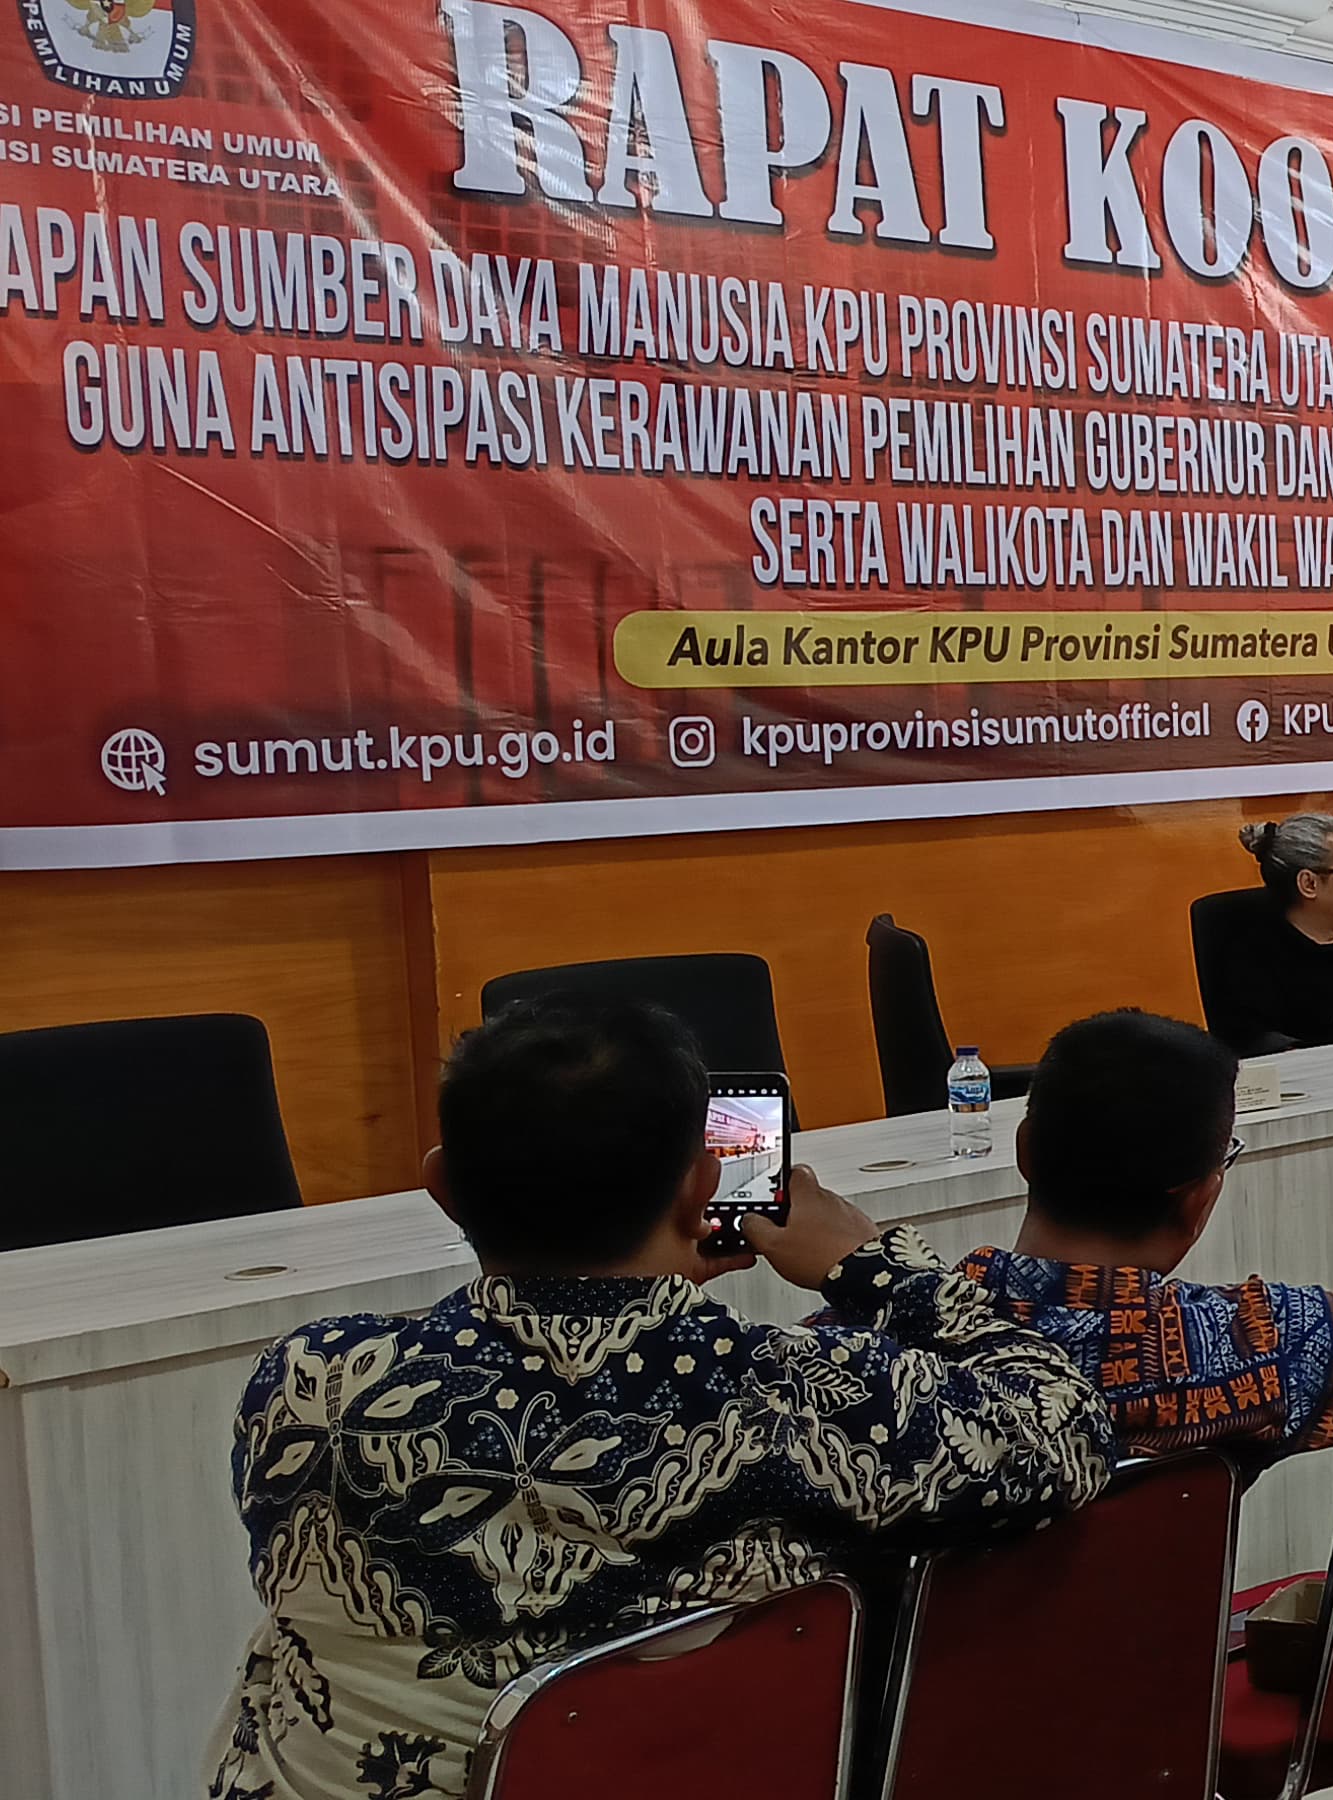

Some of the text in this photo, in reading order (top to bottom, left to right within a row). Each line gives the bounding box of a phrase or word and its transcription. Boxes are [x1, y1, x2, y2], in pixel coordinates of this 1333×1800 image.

[22, 2, 192, 95] PEMILIHAN UMUM
[33, 107, 213, 150] PEMILIHAN
[224, 133, 320, 163] UMUM
[440, 0, 1004, 250] RAPAT
[52, 146, 230, 187] SUMATERA
[239, 169, 342, 199] UTARA
[0, 203, 164, 320] APAN
[179, 221, 423, 340] SUMBER
[429, 250, 562, 352] DAYA
[579, 263, 793, 369] MANUSIA
[805, 286, 888, 377] KPU
[899, 295, 1076, 390] PROVINSI
[1086, 313, 1270, 404] SUMATERA
[63, 340, 234, 452] GUNA
[251, 355, 547, 464] ANTISIPASI
[556, 376, 850, 480] KERAWANAN
[864, 395, 1076, 487] PEMILIHAN
[1086, 410, 1267, 495] GUBERNUR
[750, 496, 888, 584] SERTA
[897, 502, 1094, 586] WALIKOTA
[1103, 508, 1174, 587] DAN
[1181, 512, 1288, 588] WAKIL
[666, 624, 768, 667] Aula
[782, 624, 919, 665] Kantor
[929, 625, 1010, 663] KPU
[1020, 622, 1161, 661] Provinsi
[1168, 623, 1318, 660] Sumatera
[195, 718, 616, 780] sumut.kpu.go.id
[742, 702, 1210, 767] kpuprovinsisumutofficial
